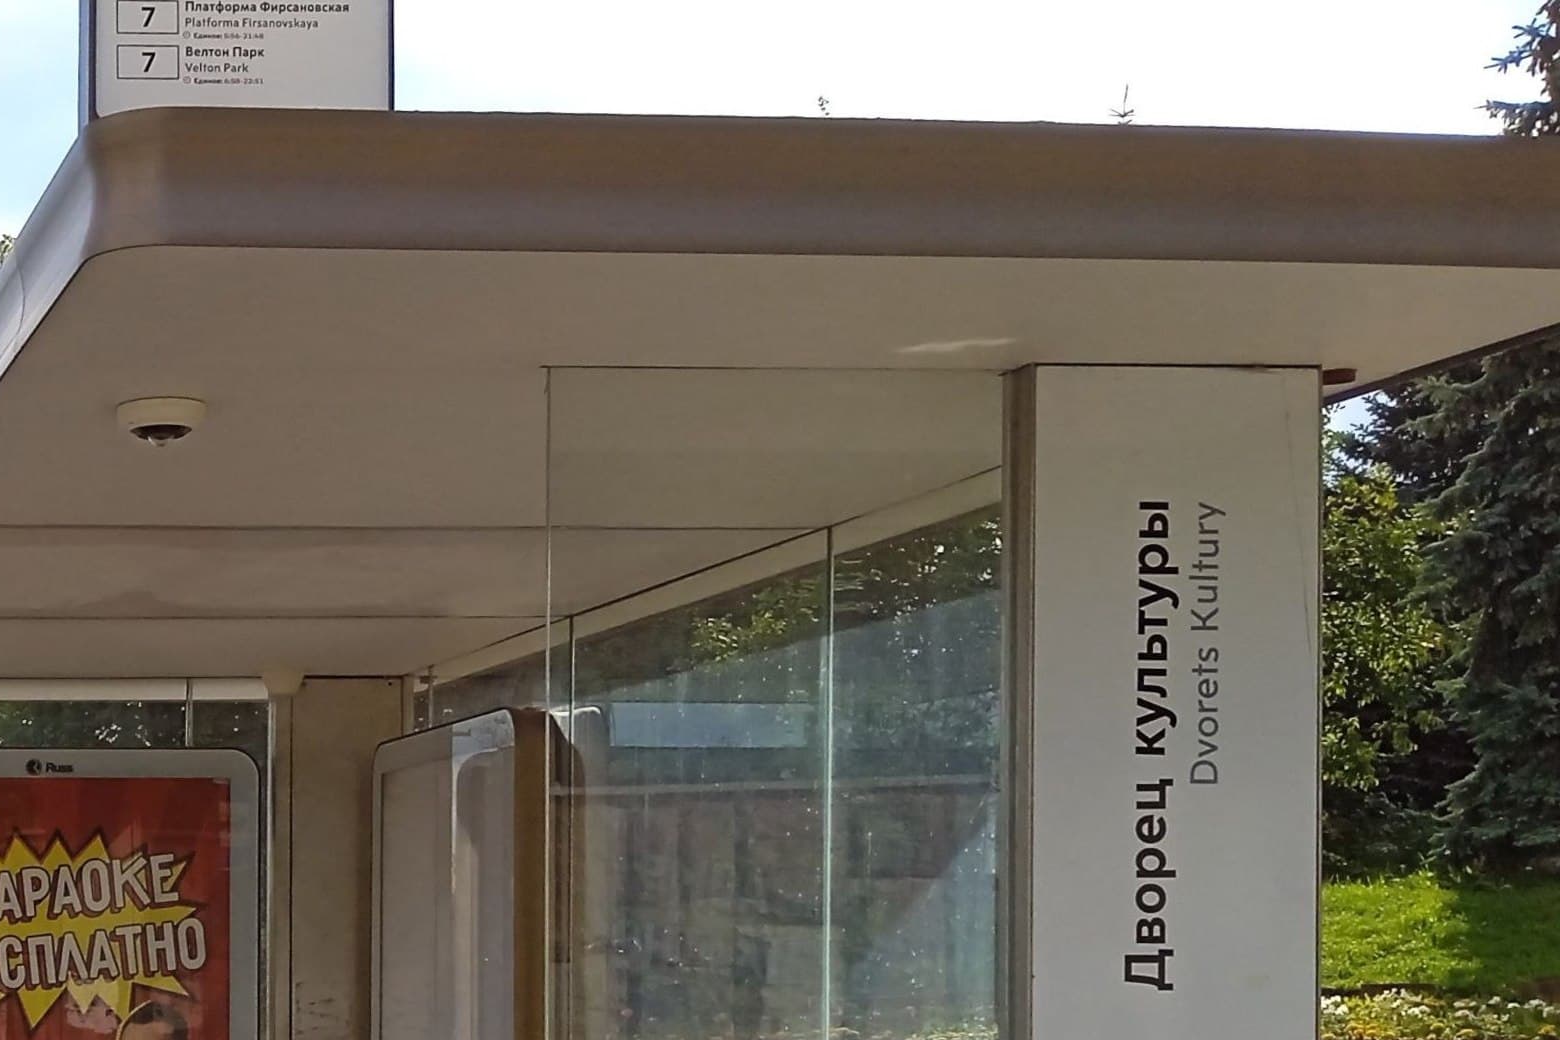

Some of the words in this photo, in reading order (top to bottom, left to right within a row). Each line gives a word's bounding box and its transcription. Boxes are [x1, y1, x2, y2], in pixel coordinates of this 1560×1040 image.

[141, 7, 156, 28] 7
[185, 1, 257, 14] Платформа
[260, 2, 350, 14] Фирсановская
[185, 17, 240, 28] Platforma
[242, 18, 319, 30] Firsanovskaya
[141, 52, 156, 73] 7
[185, 46, 230, 57] Велтон
[232, 46, 265, 59] Парк
[185, 62, 221, 73] Velton
[223, 62, 249, 73] Park
[1188, 501, 1227, 631] Kultury
[1135, 501, 1179, 756] культуры
[1190, 647, 1219, 785] Dvorets
[1124, 779, 1177, 991] Дворец
